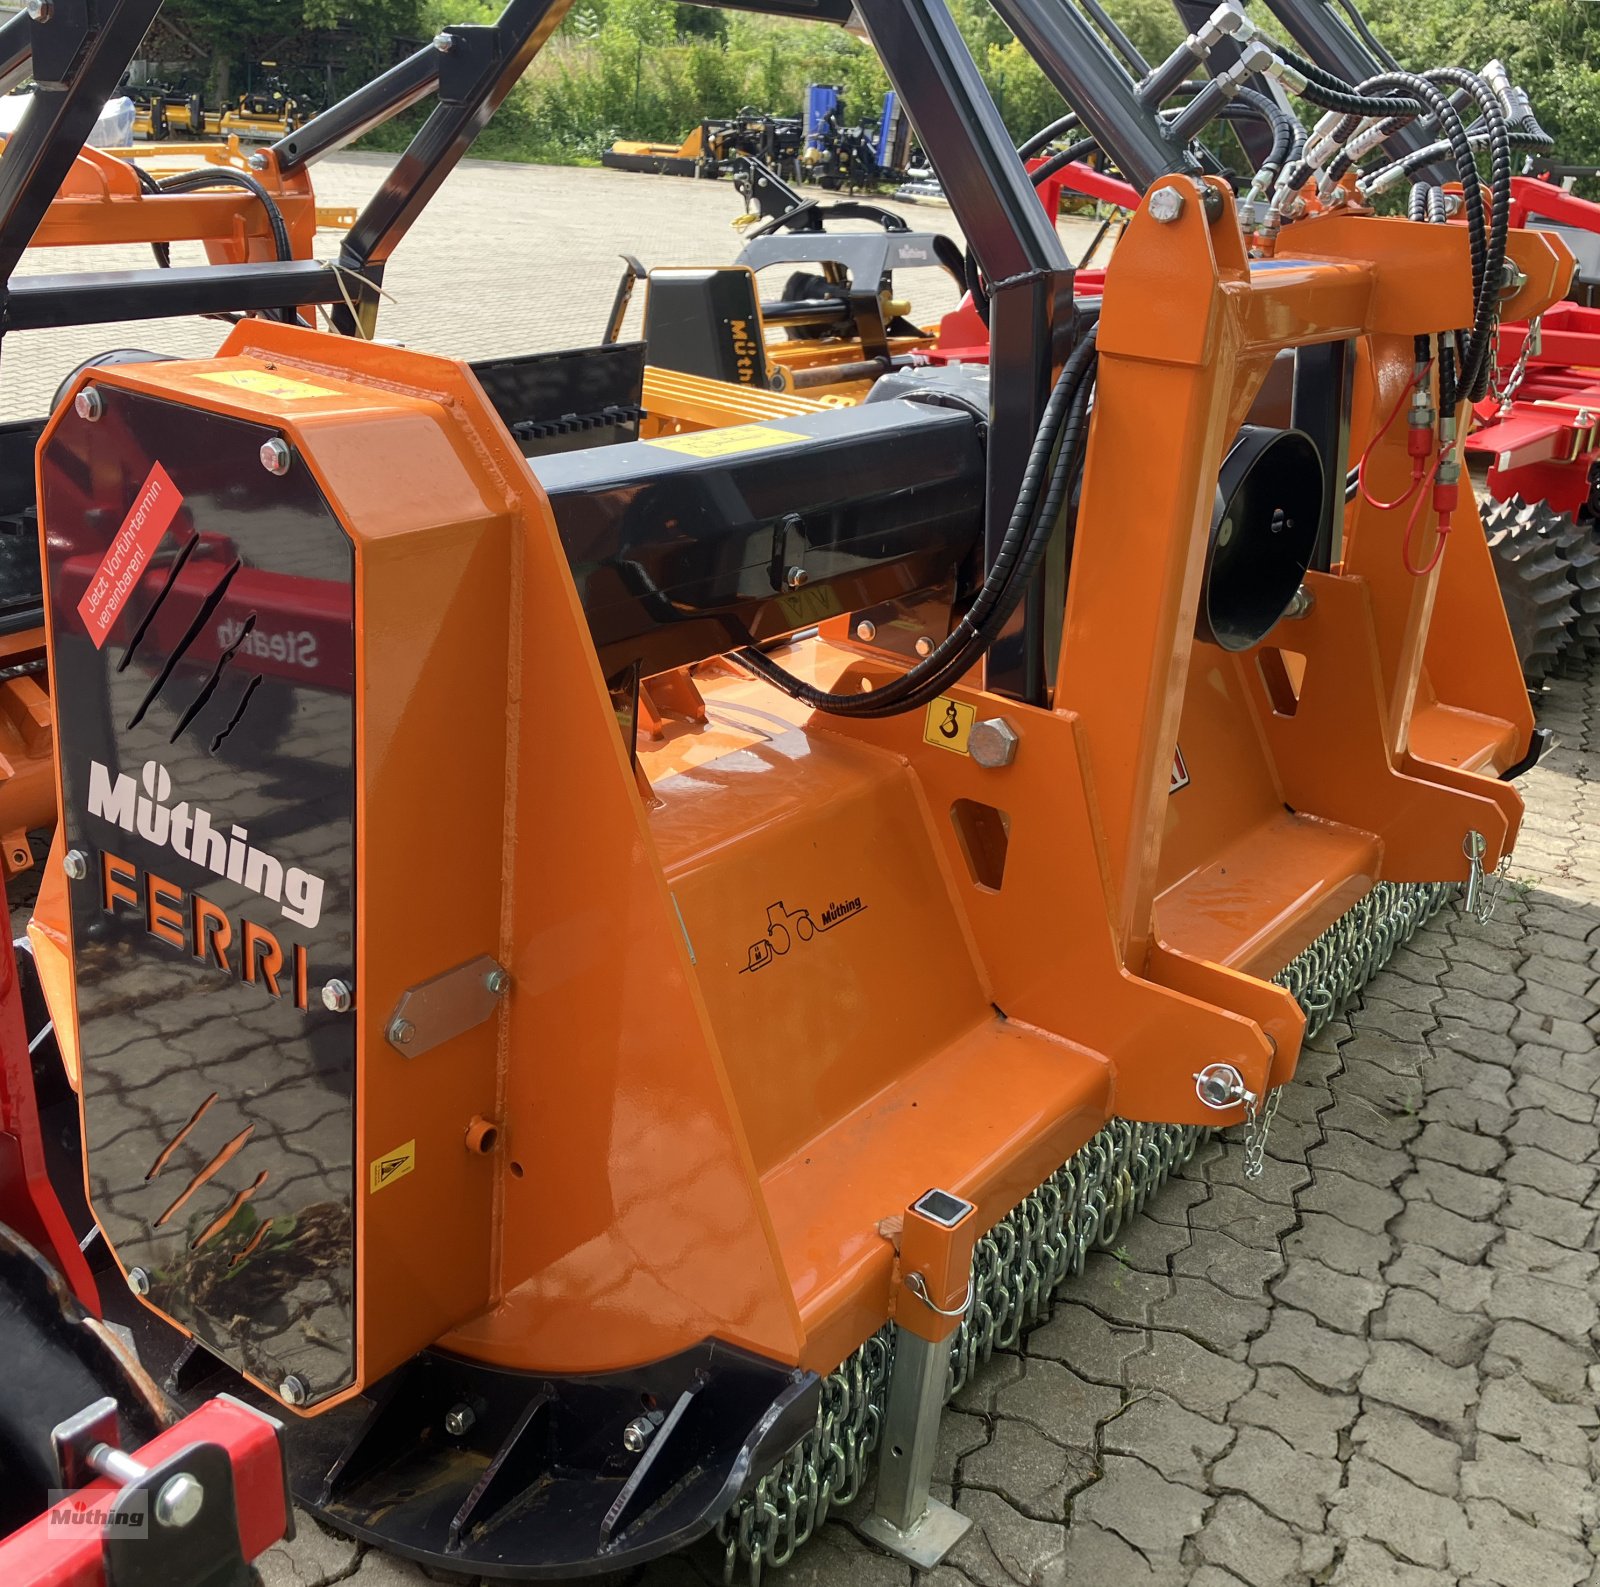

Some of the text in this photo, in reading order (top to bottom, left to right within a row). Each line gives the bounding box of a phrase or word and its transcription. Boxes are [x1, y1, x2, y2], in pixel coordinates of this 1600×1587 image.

[88, 480, 162, 614] Jetzt Vorführtermin
[97, 543, 146, 630] vereinbaren!
[88, 760, 325, 929] Müthing
[821, 897, 862, 926] Müthing
[100, 850, 308, 1015] FERRI
